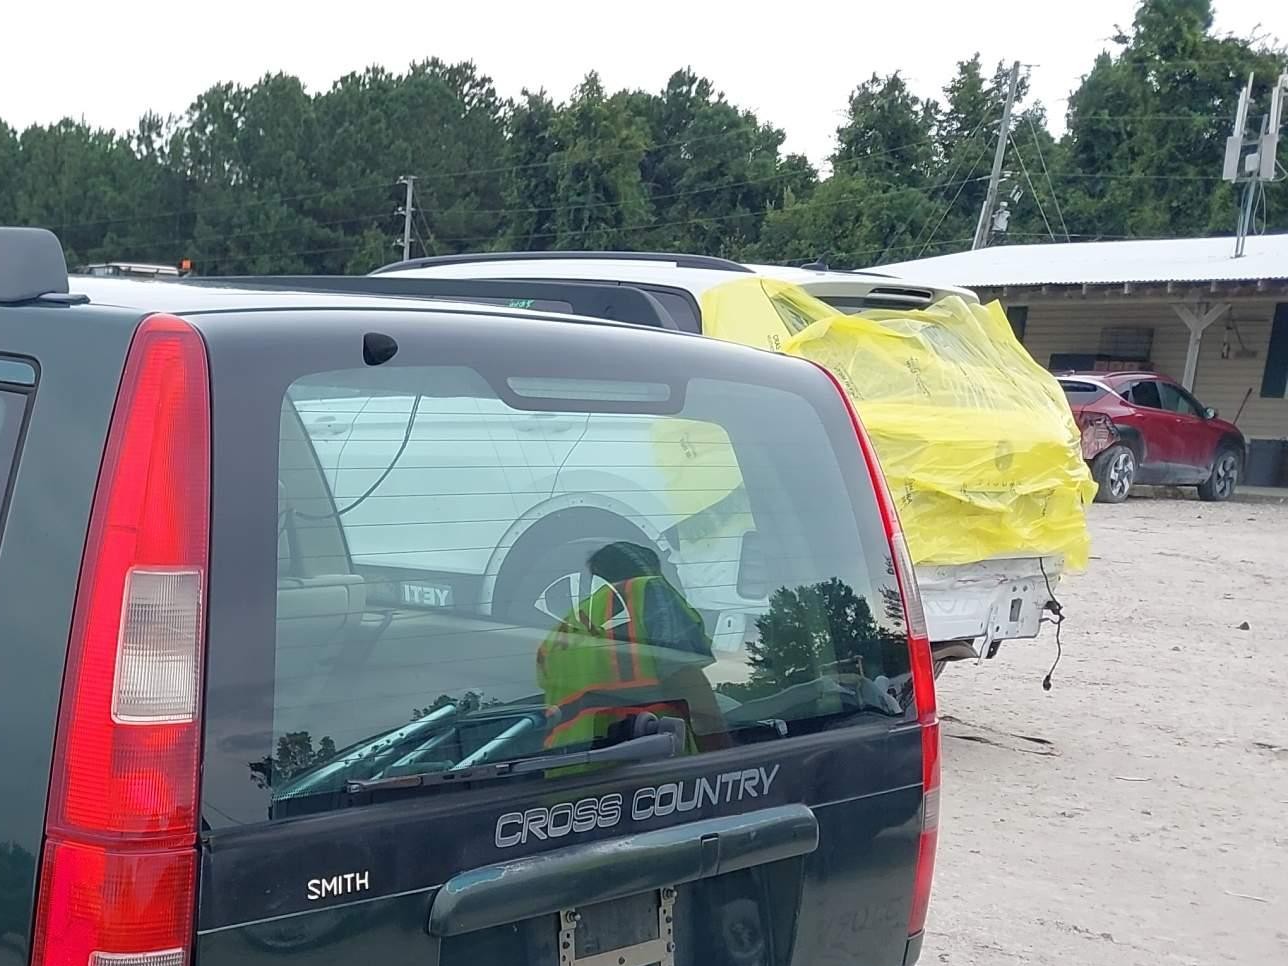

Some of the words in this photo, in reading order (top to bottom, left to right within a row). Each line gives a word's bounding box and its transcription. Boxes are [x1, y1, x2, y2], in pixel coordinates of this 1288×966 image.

[494, 793, 623, 848] CROSS
[631, 763, 781, 822] COUNTRY
[307, 870, 369, 900] SMITH
